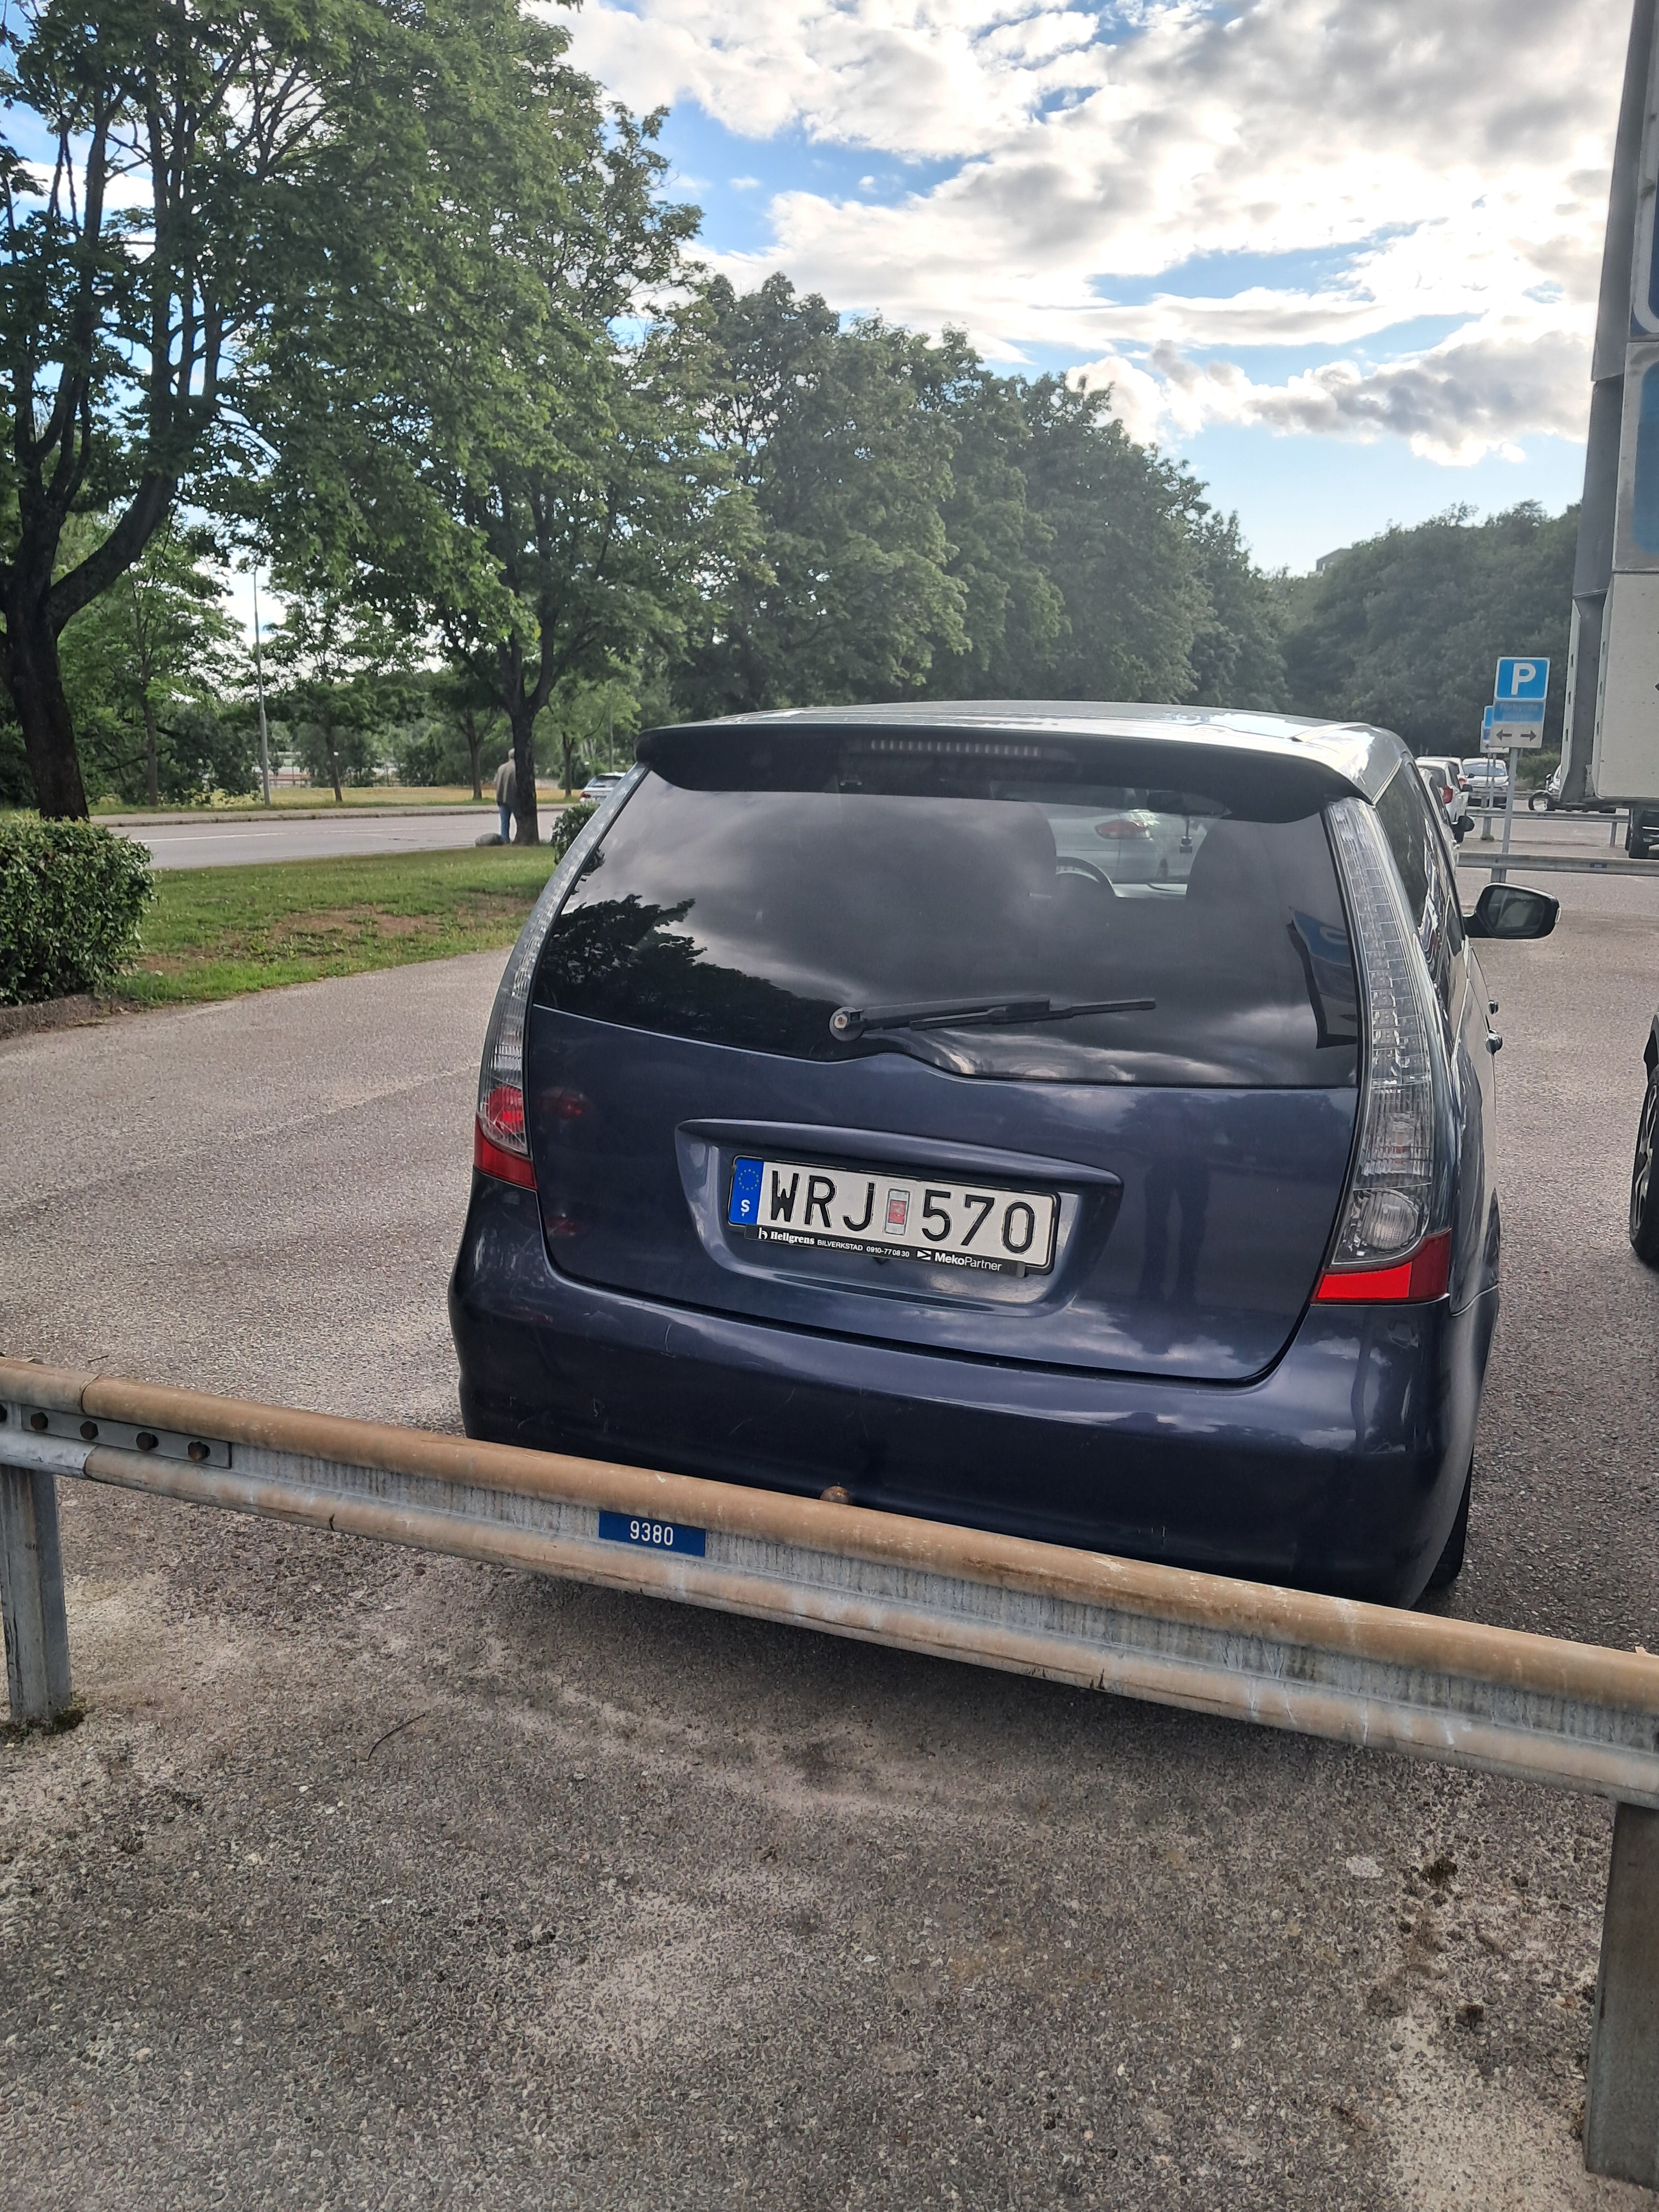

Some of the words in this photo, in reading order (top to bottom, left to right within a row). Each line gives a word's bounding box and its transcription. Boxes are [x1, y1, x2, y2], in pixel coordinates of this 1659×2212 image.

[1510, 663, 1536, 695] P
[741, 1199, 750, 1214] S
[770, 1169, 876, 1232] WRJ
[922, 1191, 1036, 1254] 570
[770, 1231, 815, 1245] Hellgrens
[817, 1239, 863, 1251] BILVERKSTAD
[935, 1251, 1002, 1271] MekoPartner
[629, 1520, 674, 1546] 9380
